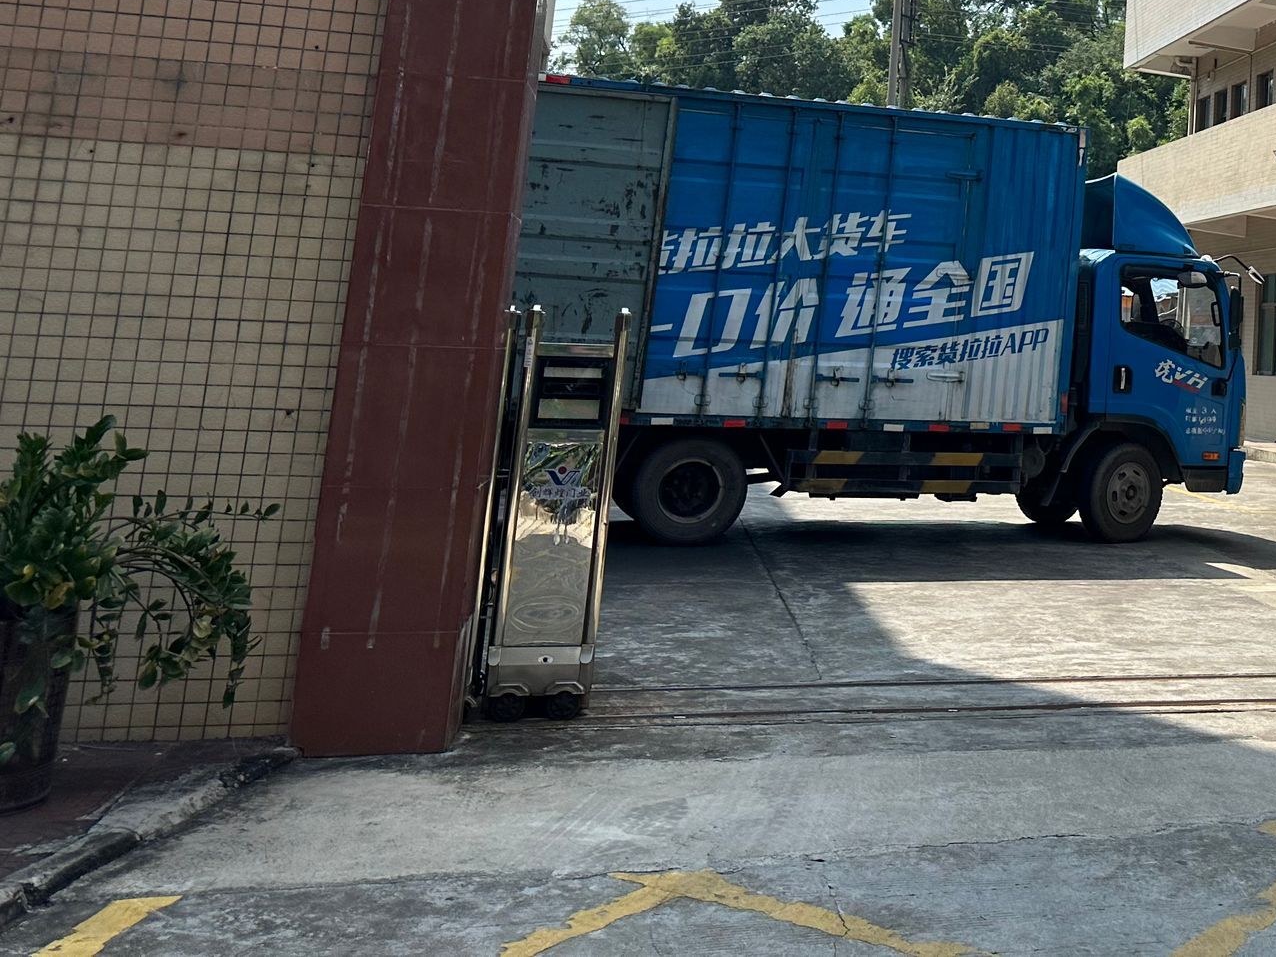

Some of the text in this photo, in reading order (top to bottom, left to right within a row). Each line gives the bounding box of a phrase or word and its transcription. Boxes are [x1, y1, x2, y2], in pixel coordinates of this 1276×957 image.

[834, 251, 1035, 338] 通全国
[890, 328, 1049, 371] 搜索货拉拉APP
